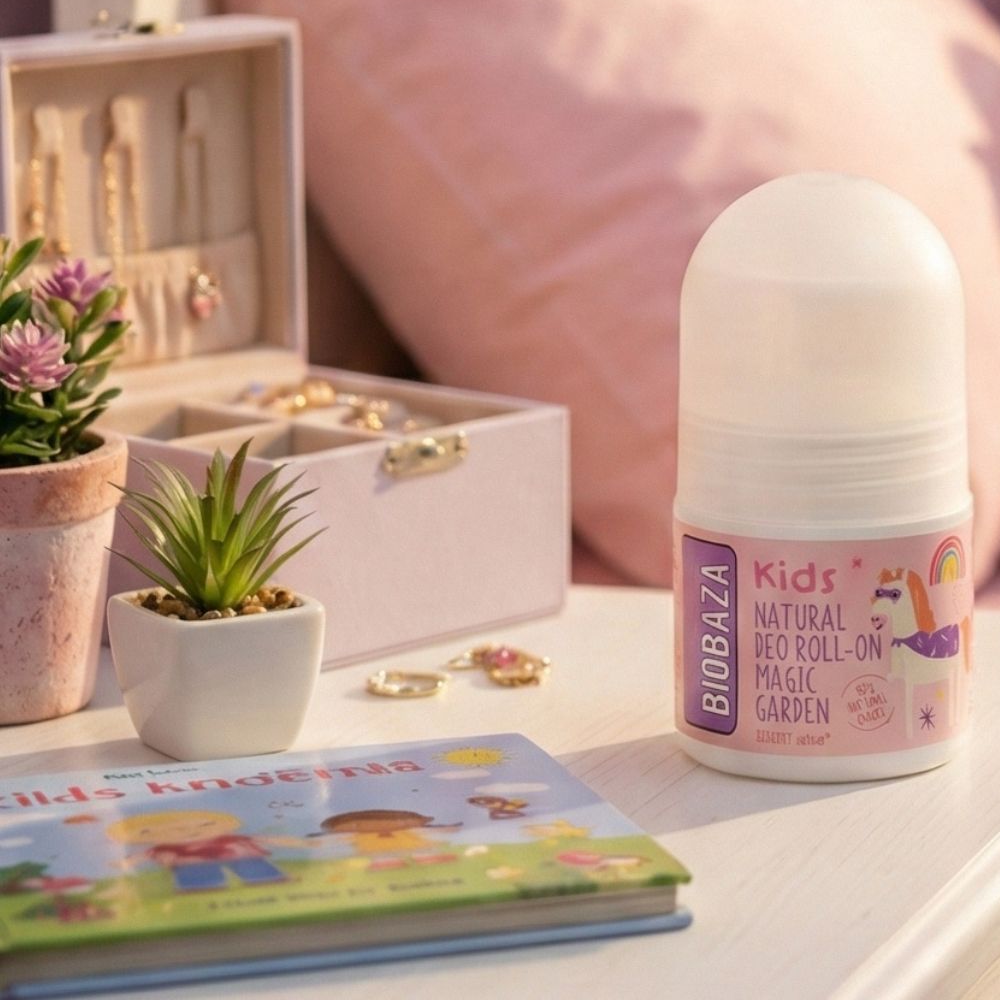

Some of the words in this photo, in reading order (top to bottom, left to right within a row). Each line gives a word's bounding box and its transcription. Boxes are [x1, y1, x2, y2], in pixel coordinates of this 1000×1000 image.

[753, 560, 837, 595] Kids
[755, 601, 846, 631] NATURAL
[701, 564, 730, 716] BIOBAZA
[755, 632, 788, 660] DEO
[796, 633, 882, 662] ROLL-ON
[755, 664, 817, 694] MAGIC
[756, 694, 830, 725] GARDEN
